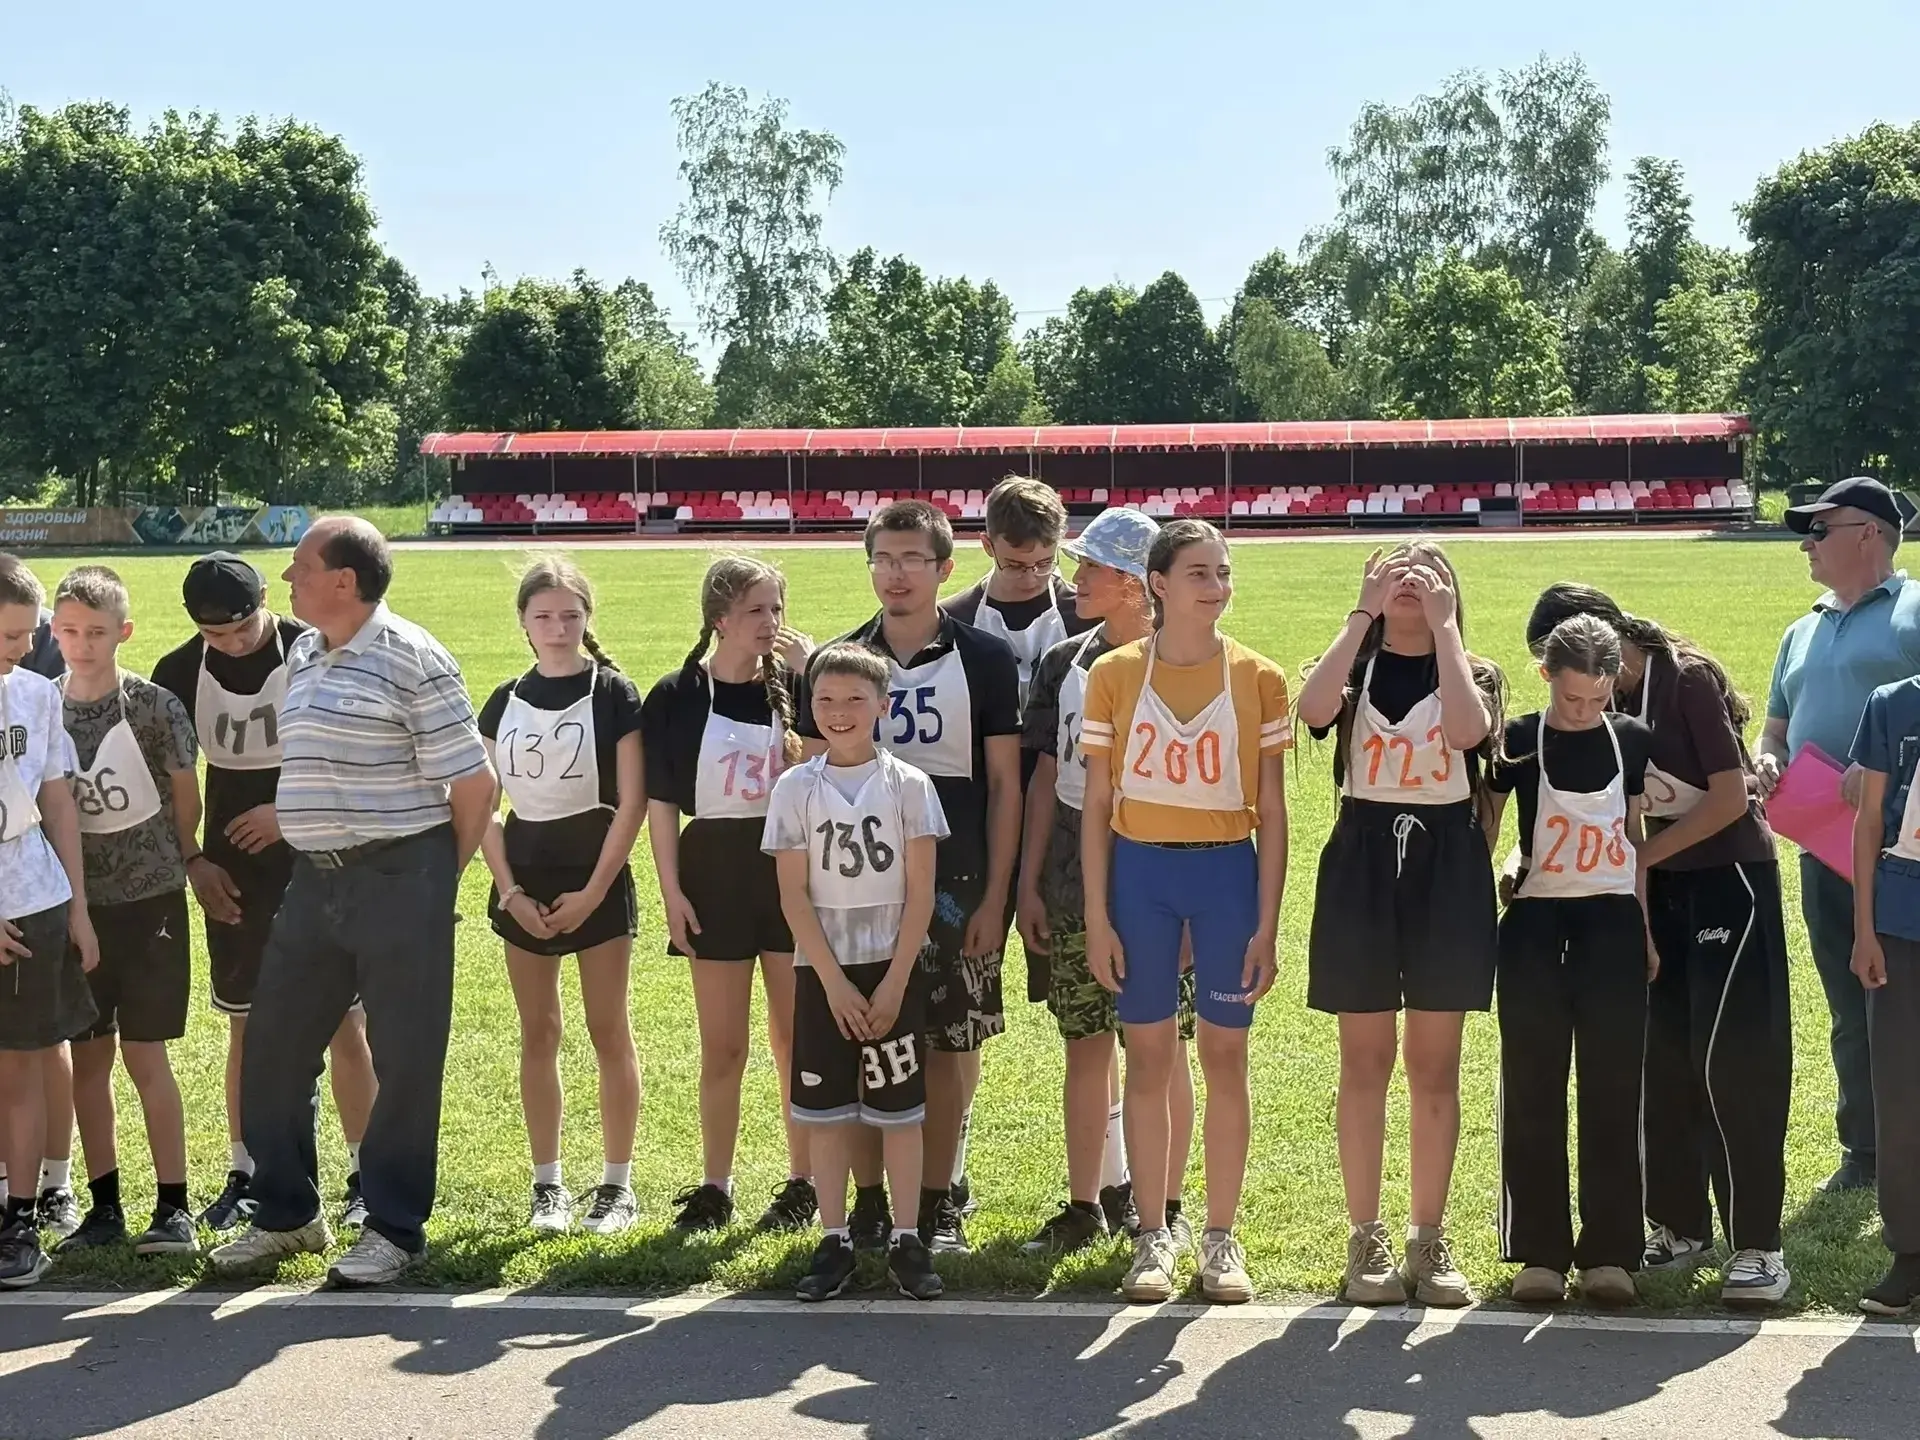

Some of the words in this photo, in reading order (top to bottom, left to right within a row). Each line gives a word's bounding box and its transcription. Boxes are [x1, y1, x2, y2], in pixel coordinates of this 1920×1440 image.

[5, 510, 87, 526] ЗДОРОВЫЙ
[501, 721, 585, 780] 132
[1133, 721, 1222, 785] 200
[1362, 725, 1451, 788] 123
[816, 815, 894, 878] 136
